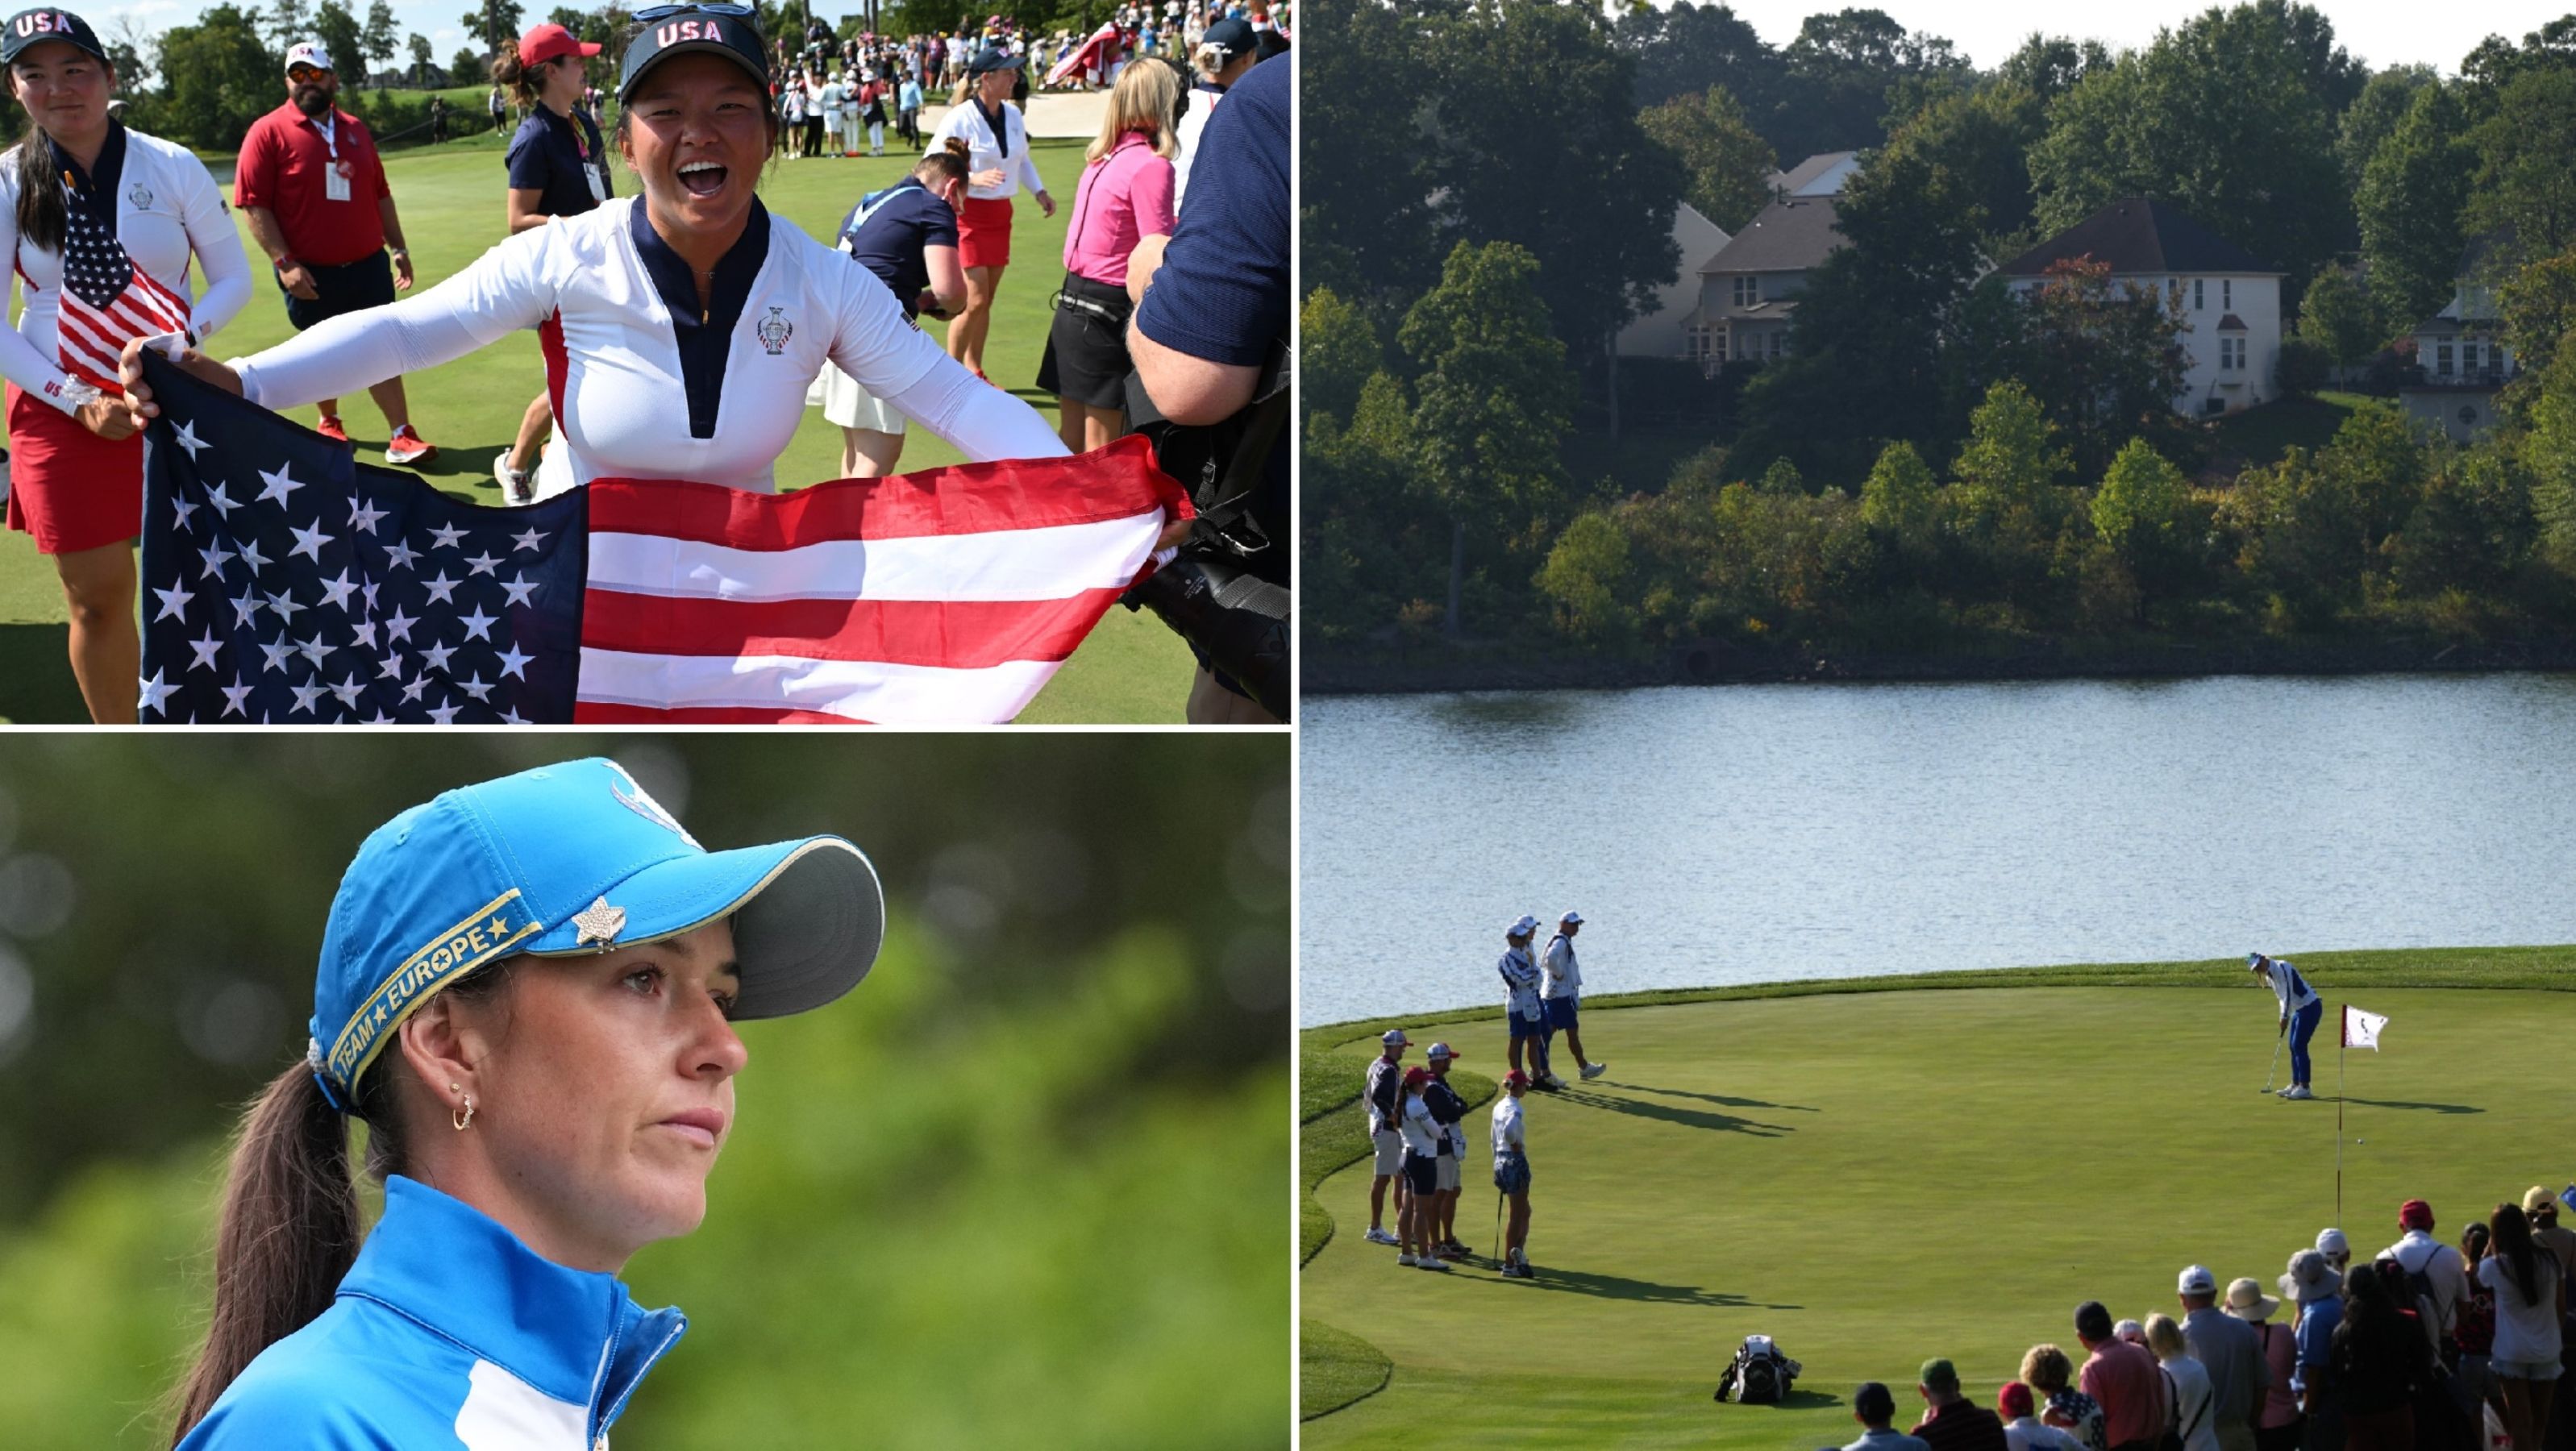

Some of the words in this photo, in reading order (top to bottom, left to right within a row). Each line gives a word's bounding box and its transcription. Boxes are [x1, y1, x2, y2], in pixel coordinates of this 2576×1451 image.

[16, 11, 74, 38] USA
[656, 20, 722, 48] USA
[44, 380, 62, 397] US
[337, 1014, 376, 1076] TEAM
[386, 926, 491, 1012] EUROPE
